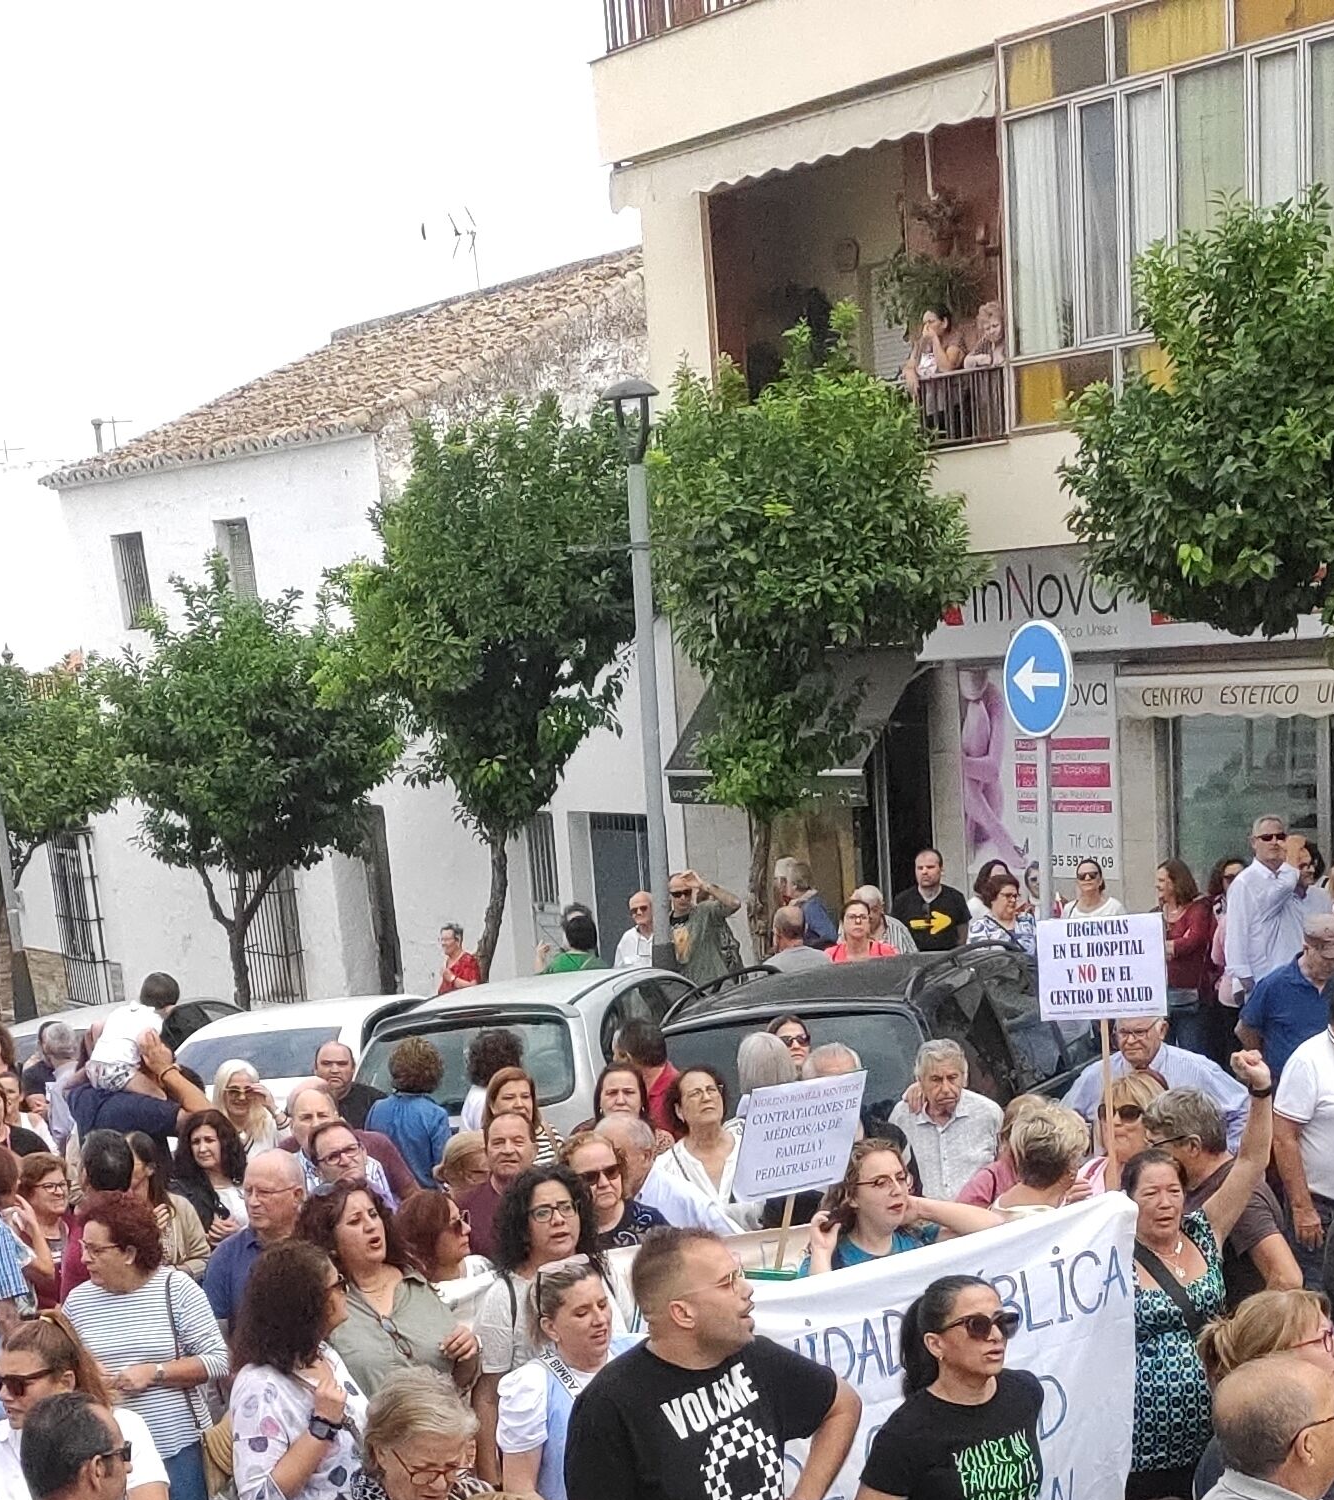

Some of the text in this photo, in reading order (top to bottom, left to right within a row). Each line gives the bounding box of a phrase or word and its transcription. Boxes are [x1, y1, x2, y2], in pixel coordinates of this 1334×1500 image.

[1141, 687, 1203, 706] CENTRO
[1220, 684, 1300, 705] ESTETICO
[1087, 833, 1114, 849] Citas
[1101, 856, 1114, 868] 09
[1067, 919, 1128, 938] URGENCIAS
[1053, 940, 1145, 959] EN EL HOSPITAL
[1067, 964, 1133, 984] Y NO EN EL
[1050, 986, 1153, 1006] CENTRO DE SALUD
[752, 1097, 858, 1125] CONTRATACIONES DE
[764, 1117, 843, 1142] MÉDICOS/AS DE
[776, 1138, 824, 1158] FAMILIA Y
[756, 1161, 809, 1181] PEDIATRAS
[952, 1428, 1030, 1473] YOU'RE MY
[961, 1453, 1038, 1498] FAVOURITE
